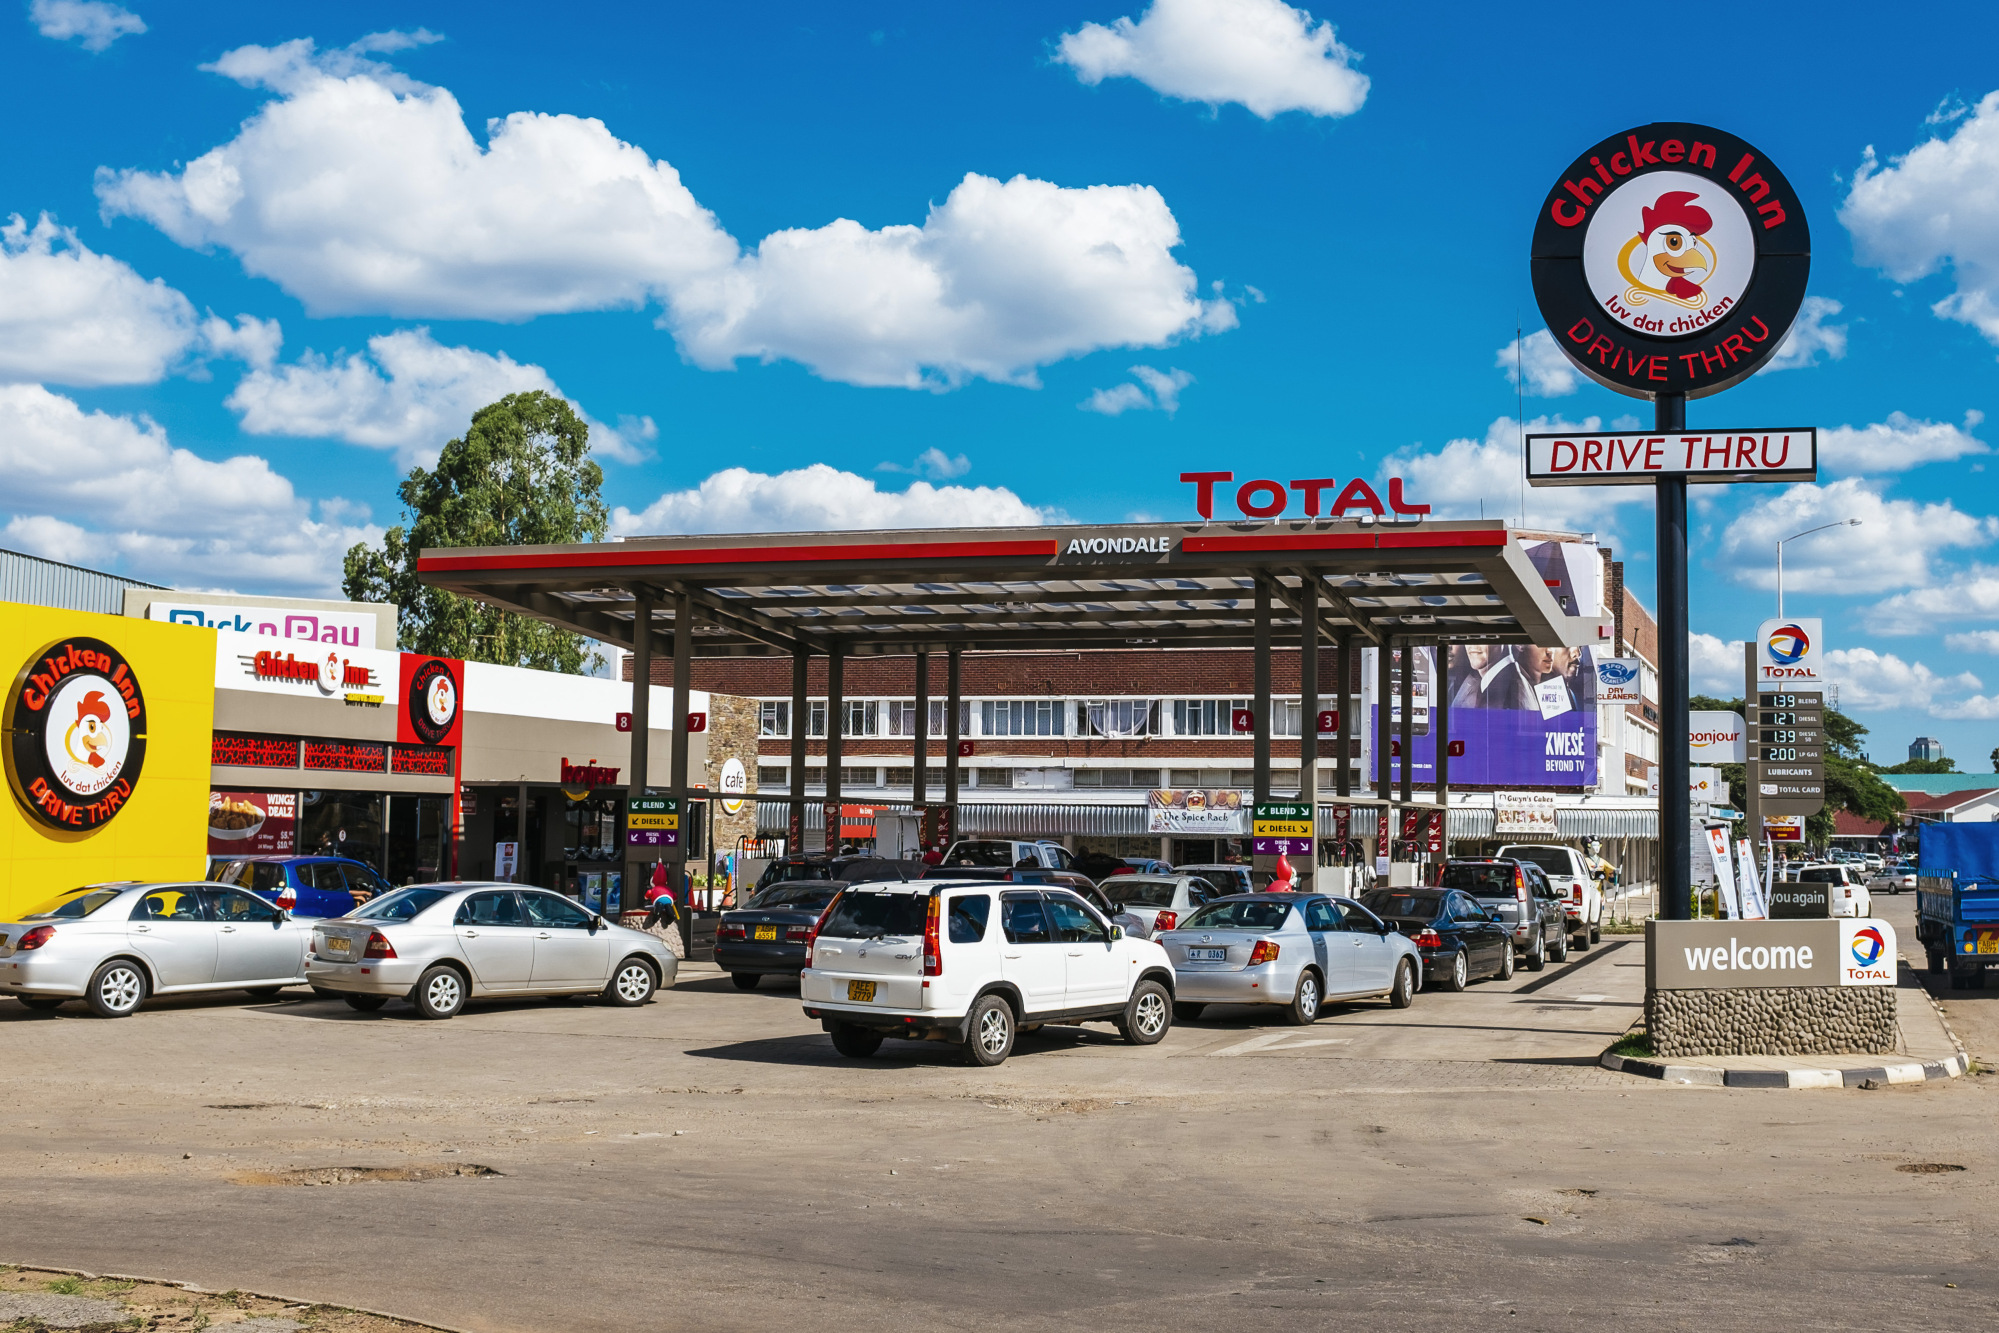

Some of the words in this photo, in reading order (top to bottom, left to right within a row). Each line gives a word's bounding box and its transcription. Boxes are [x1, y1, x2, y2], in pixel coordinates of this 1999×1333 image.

[1551, 135, 1717, 227] Chicken
[1728, 153, 1786, 229] Inn
[1605, 294, 1631, 320] luv
[1633, 313, 1664, 334] dat
[1669, 296, 1734, 334] chicken
[1567, 317, 1668, 381] DRIVE
[1679, 315, 1769, 379] THRU
[1550, 438, 1666, 473] DRIVE
[1680, 435, 1790, 470] THRU
[1180, 471, 1431, 519] TOTAL
[1067, 536, 1170, 555] AVONDALE
[253, 651, 318, 680] Chicken
[343, 658, 369, 684] inn
[1605, 663, 1625, 671] SPOT
[1762, 666, 1816, 677] TOTAL
[24, 644, 111, 711] Chicken
[110, 663, 141, 719] Inn
[417, 664, 444, 690] Chicken
[1774, 695, 1795, 707] 1.39
[620, 716, 628, 728] 8
[693, 716, 700, 728] 7
[1239, 715, 1248, 727] 4
[1324, 715, 1332, 727] 3
[1774, 713, 1795, 725] 1.27
[417, 717, 435, 738] DRIVE
[1546, 727, 1585, 755] KWESÉ
[1774, 731, 1795, 743] 1.39
[963, 744, 969, 753] 5
[1770, 748, 1795, 760] 2.00
[1546, 759, 1574, 771] BEYOND
[1575, 759, 1585, 771] TV
[60, 769, 74, 787] luv
[75, 781, 91, 793] dat
[93, 760, 122, 792] chicken
[1768, 768, 1812, 776] LUBRICANTS
[29, 776, 83, 825] DRIVE
[85, 778, 131, 823] THRU
[267, 793, 295, 805] WINGZ
[642, 801, 664, 809] BLEND
[1507, 795, 1532, 803] Gwyn's
[268, 806, 293, 817] DEALZ
[1270, 807, 1296, 815] BLEND
[1163, 812, 1180, 821] The
[1182, 812, 1205, 823] Spice
[1207, 812, 1229, 822] Rack
[1269, 825, 1297, 833] DIESEL
[1278, 845, 1287, 853] 50
[1770, 893, 1790, 906] you
[1792, 890, 1824, 906] again
[1208, 950, 1224, 958] 0362
[1684, 937, 1813, 970] welcome
[1847, 968, 1890, 979] TOTAL
[855, 981, 870, 991] AEE
[852, 991, 871, 1001] 3779
